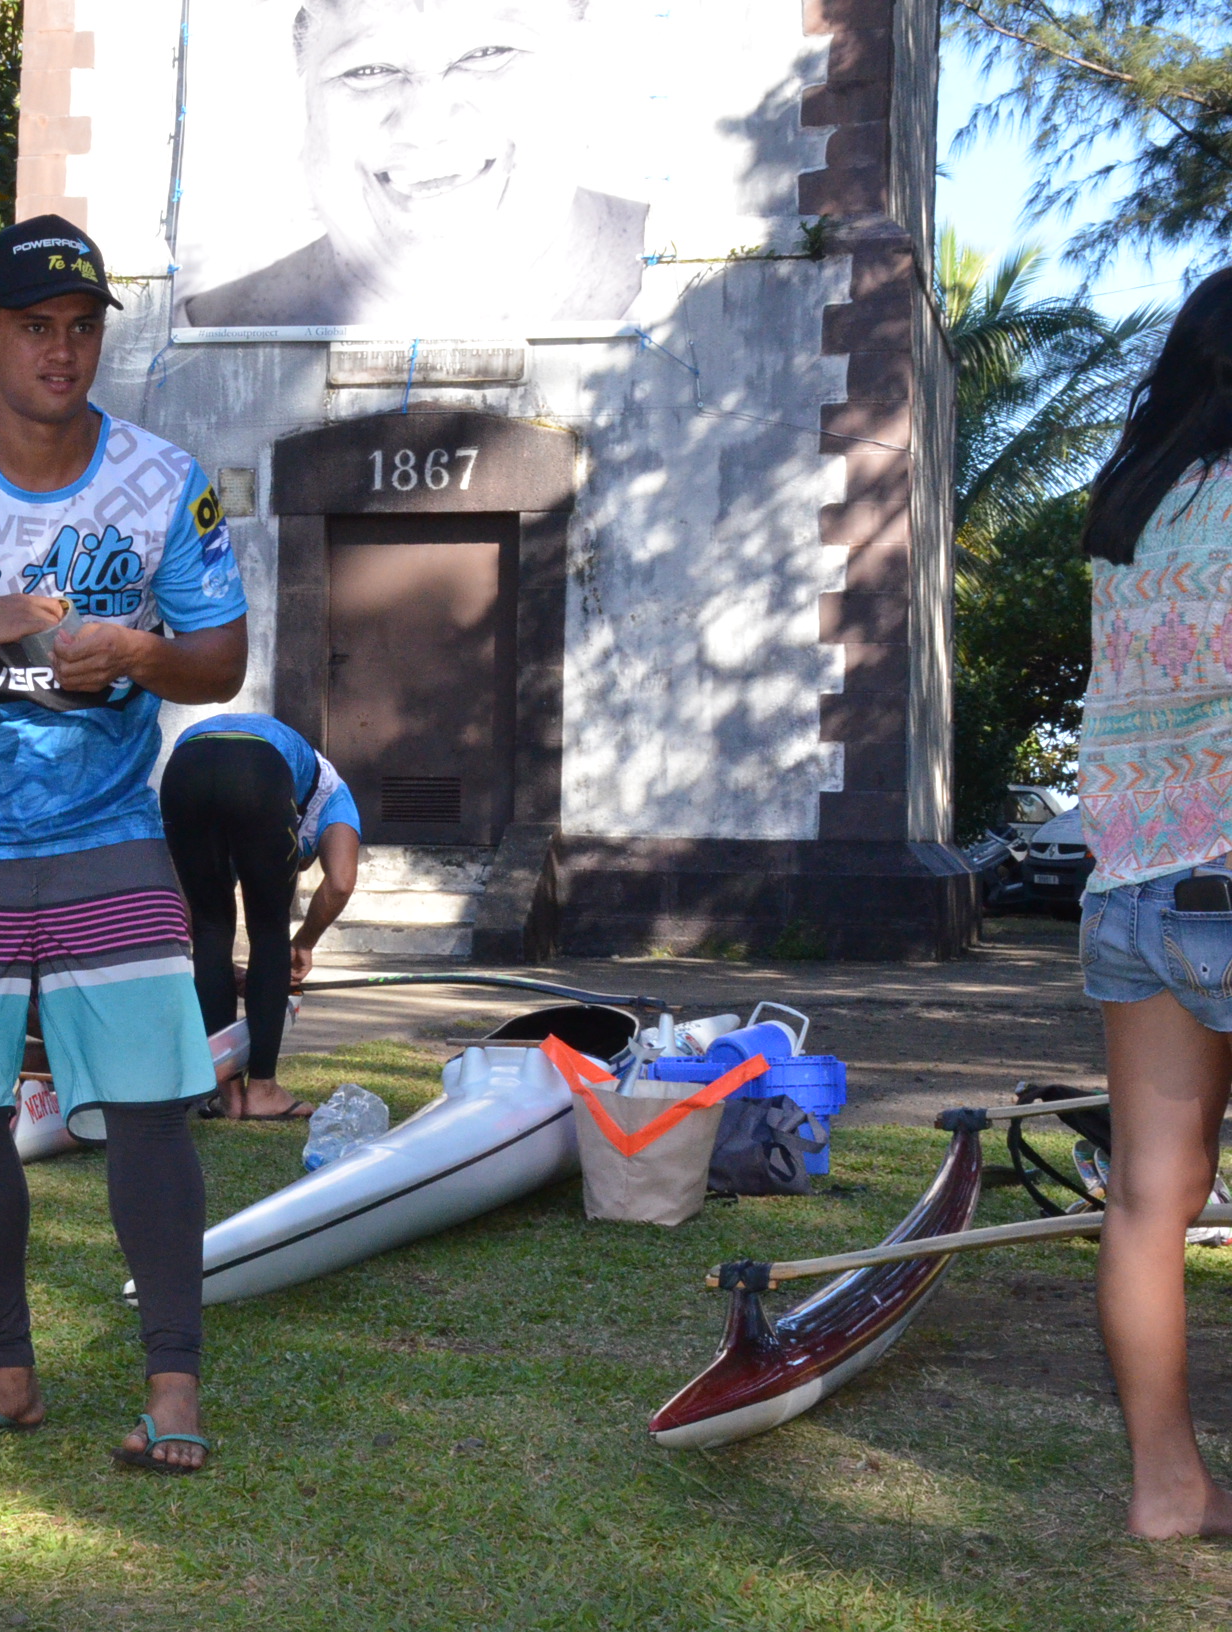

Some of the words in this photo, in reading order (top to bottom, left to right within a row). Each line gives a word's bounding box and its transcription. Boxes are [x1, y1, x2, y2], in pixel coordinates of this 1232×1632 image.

[48, 255, 66, 271] Te
[198, 329, 279, 339] #insideoutproject
[315, 326, 348, 336] Global
[369, 446, 479, 491] 1867
[22, 524, 145, 595] Aito
[64, 588, 142, 618] 2016
